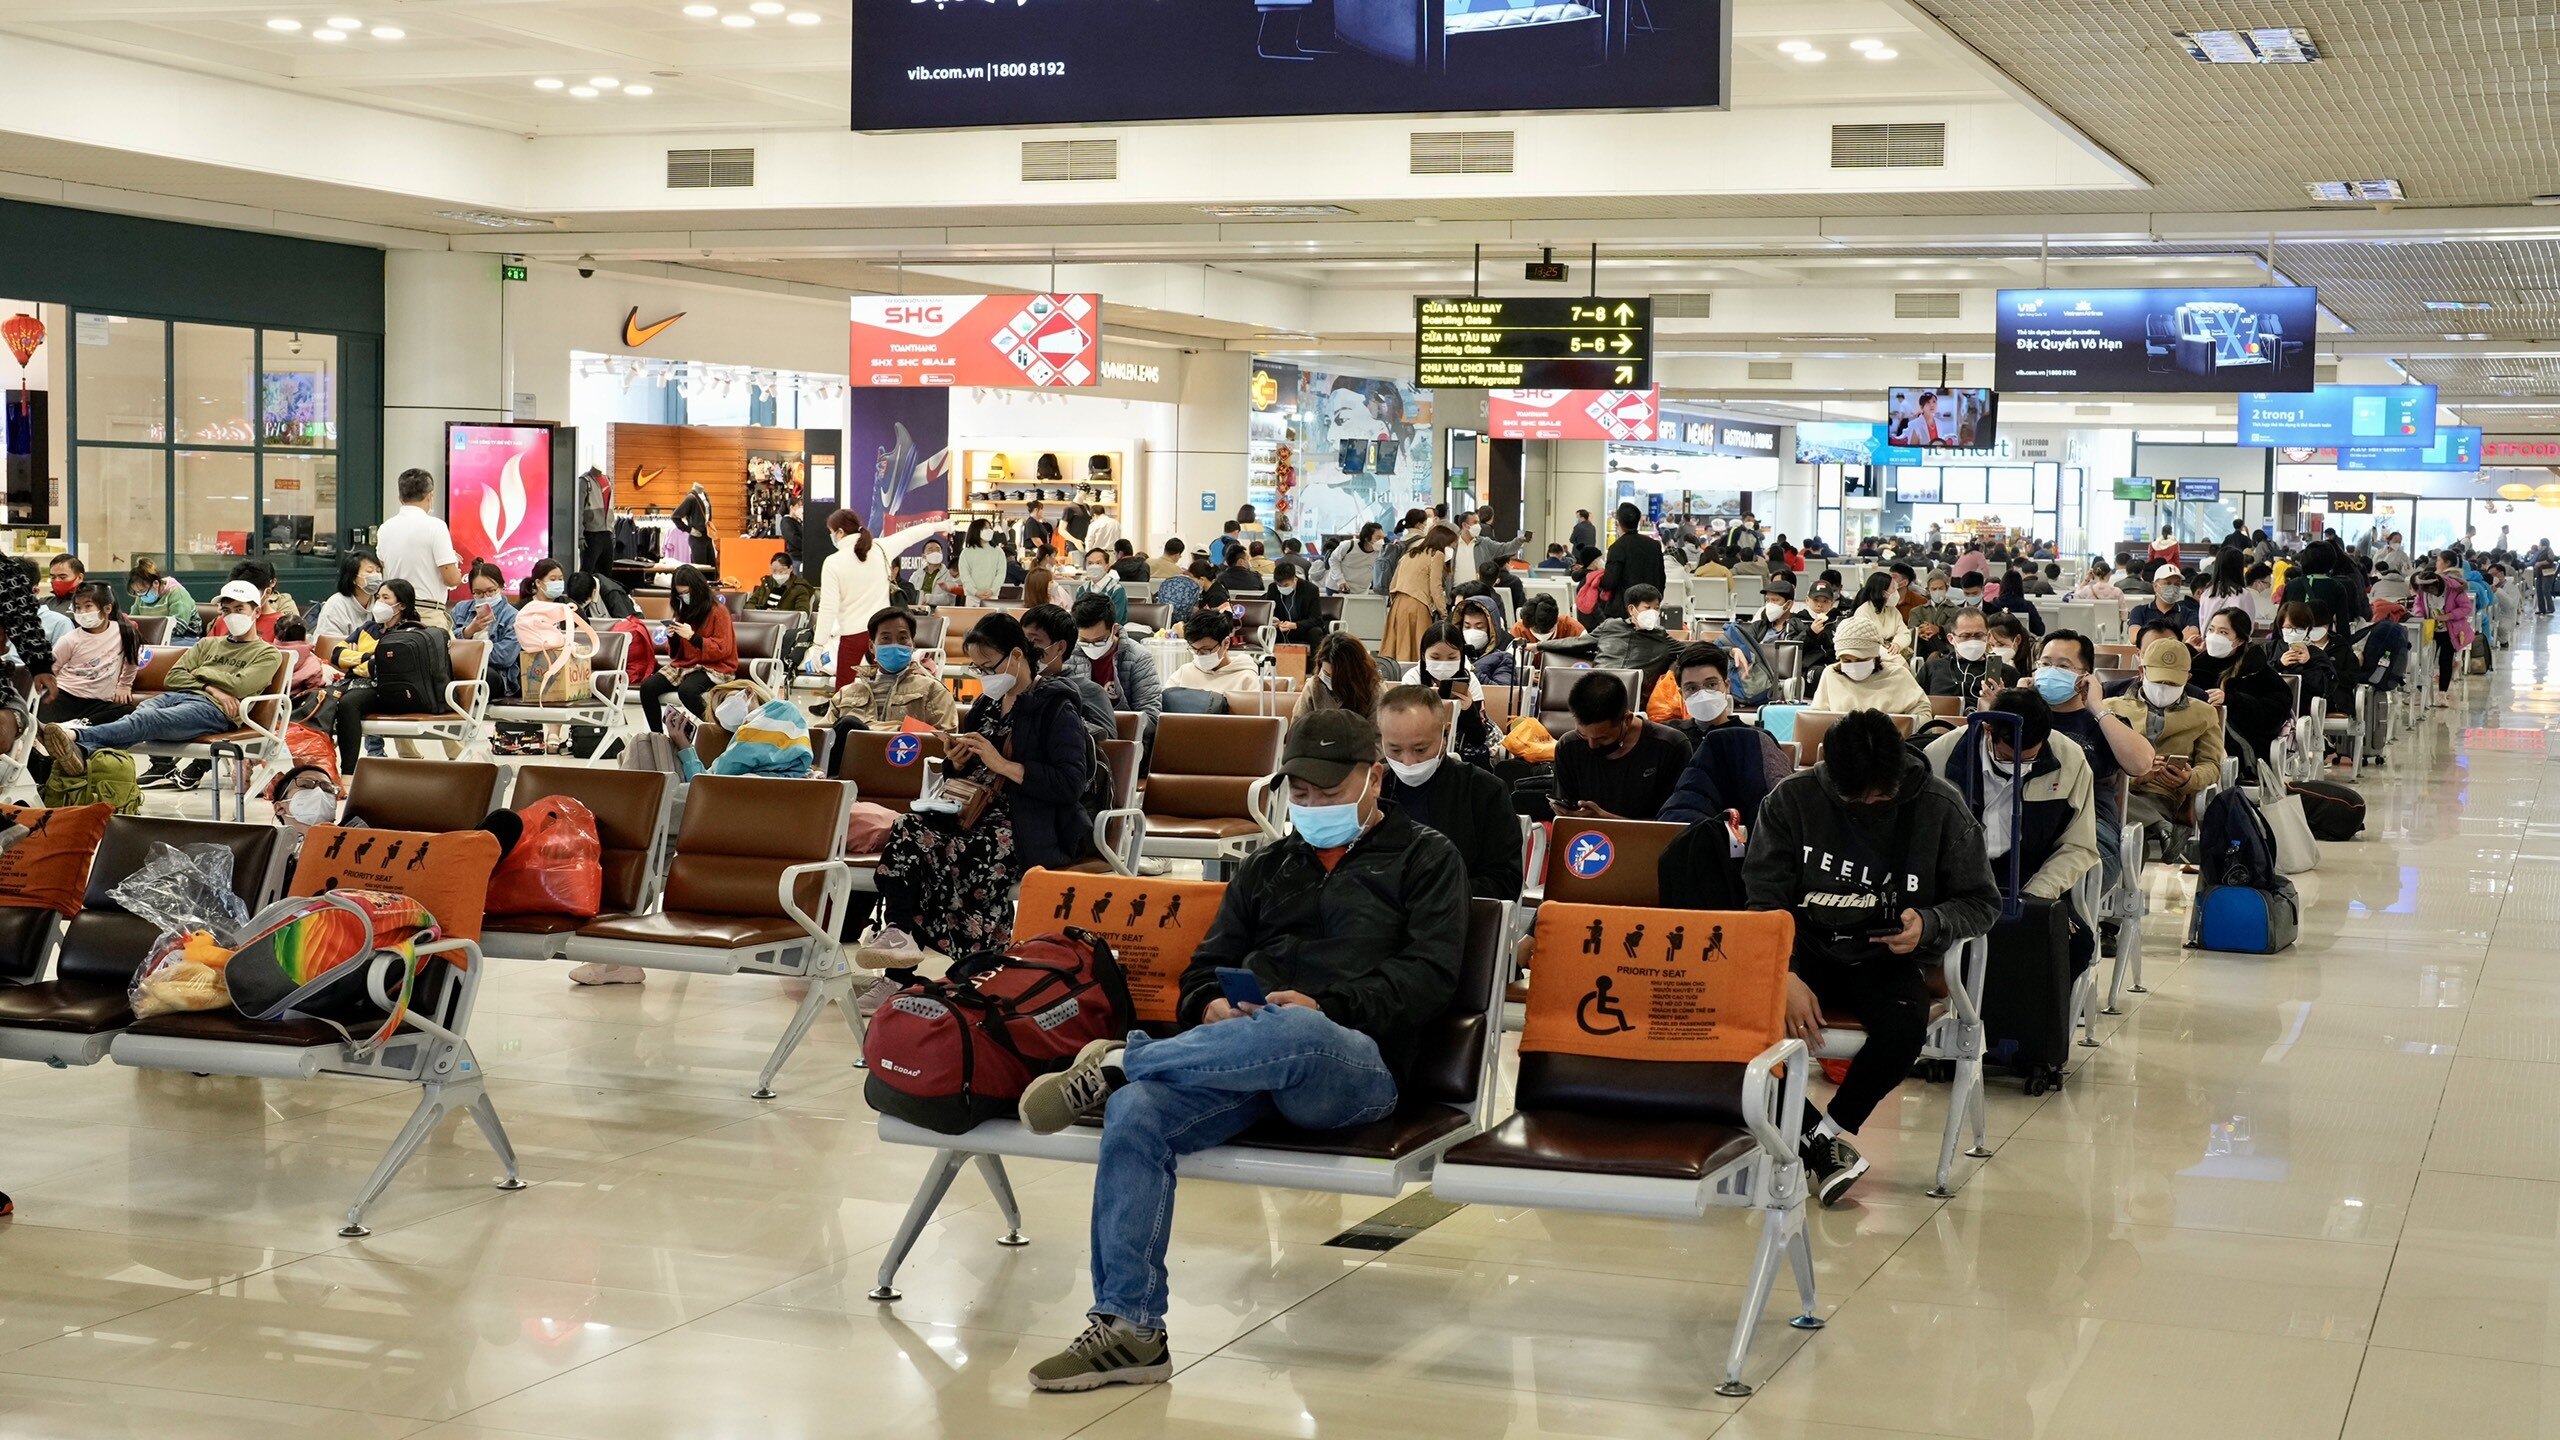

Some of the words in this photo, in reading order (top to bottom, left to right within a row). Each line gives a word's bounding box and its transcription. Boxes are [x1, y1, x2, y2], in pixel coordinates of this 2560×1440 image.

[908, 66, 983, 80] vib.com.vn
[1029, 61, 1065, 76] 8192
[1422, 302, 1443, 313] CỬA
[1444, 304, 1459, 313] RA
[1460, 302, 1481, 313] TÀU
[1482, 304, 1502, 313] BAY
[885, 306, 943, 324] SHG
[1422, 316, 1463, 326] Boarding
[1465, 316, 1491, 325] Gates
[1421, 331, 1443, 342] CỬA
[1444, 333, 1459, 342] RA
[1460, 331, 1480, 342] TÀU
[1481, 334, 1501, 342] BAY
[1421, 345, 1463, 355] Boarding
[1464, 345, 1491, 354] Gates
[2016, 339, 2039, 351] Đặc
[2041, 337, 2079, 352] Quyền
[2081, 338, 2097, 349] Vô
[2098, 339, 2123, 351] Hạn
[1421, 364, 1441, 373] KHU
[1443, 364, 1459, 373] VUI
[1461, 363, 1484, 373] CHƠI
[1486, 361, 1506, 373] TRẺ
[1508, 364, 1523, 373] EM
[1420, 375, 1466, 385] Children's
[1469, 375, 1520, 387] Playground
[2252, 409, 2260, 419] 2
[2262, 410, 2295, 422] trong
[2298, 410, 2304, 420] 1
[2022, 439, 2049, 447] FASTFOOD
[2161, 480, 2171, 494] 7
[343, 869, 374, 880] PRIORITY
[1121, 934, 1144, 942] SEAT
[1616, 966, 1660, 977] PRIORITY
[1662, 969, 1687, 978] SEAT
